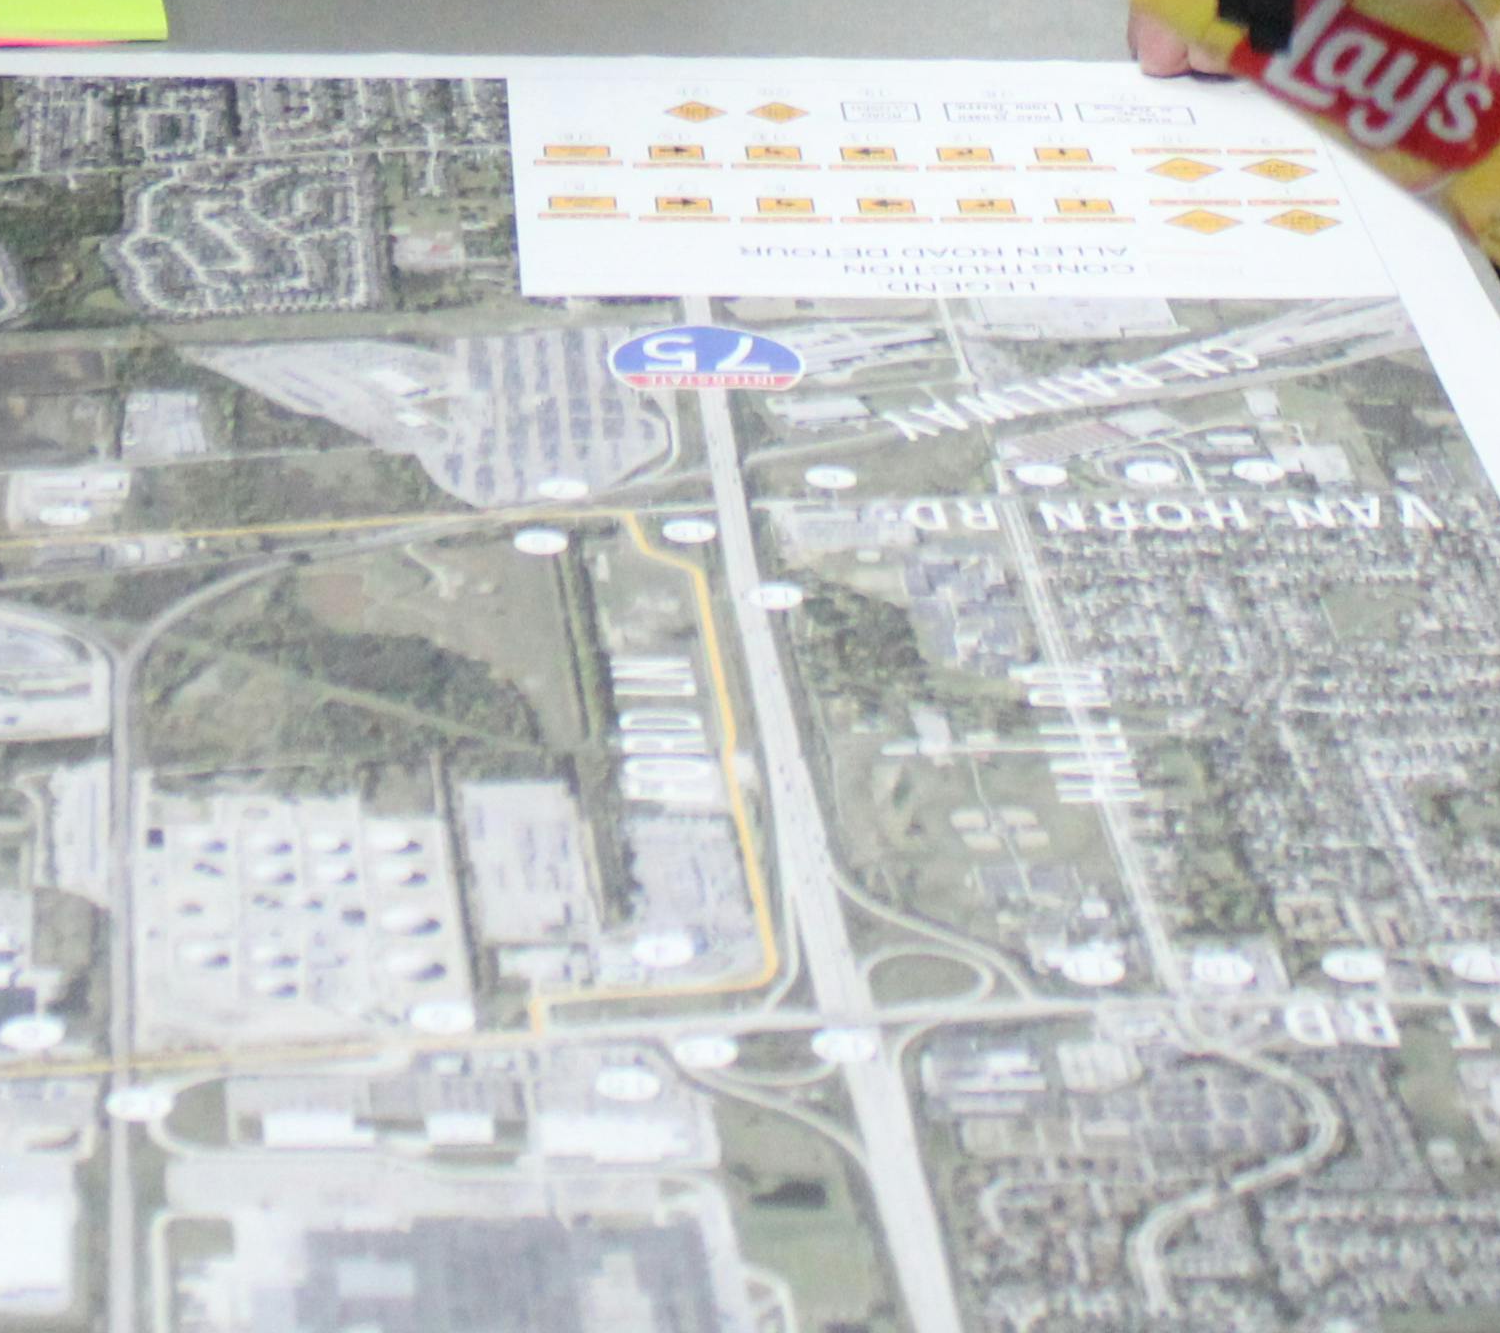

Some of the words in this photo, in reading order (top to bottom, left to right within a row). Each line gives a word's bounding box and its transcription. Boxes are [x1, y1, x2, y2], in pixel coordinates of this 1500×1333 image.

[738, 244, 888, 259] DETOUR
[901, 245, 1003, 258] ROAD
[1011, 245, 1128, 258] ALLEN
[842, 263, 1135, 276] CONSTRUCTION
[642, 334, 772, 373] 75
[648, 375, 775, 387] INTERSTATE
[879, 361, 1162, 442] RAILWAY
[907, 498, 999, 532] RD
[1038, 496, 1247, 533] HORN
[1288, 492, 1442, 538] VAN
[1283, 1000, 1400, 1046] RD
